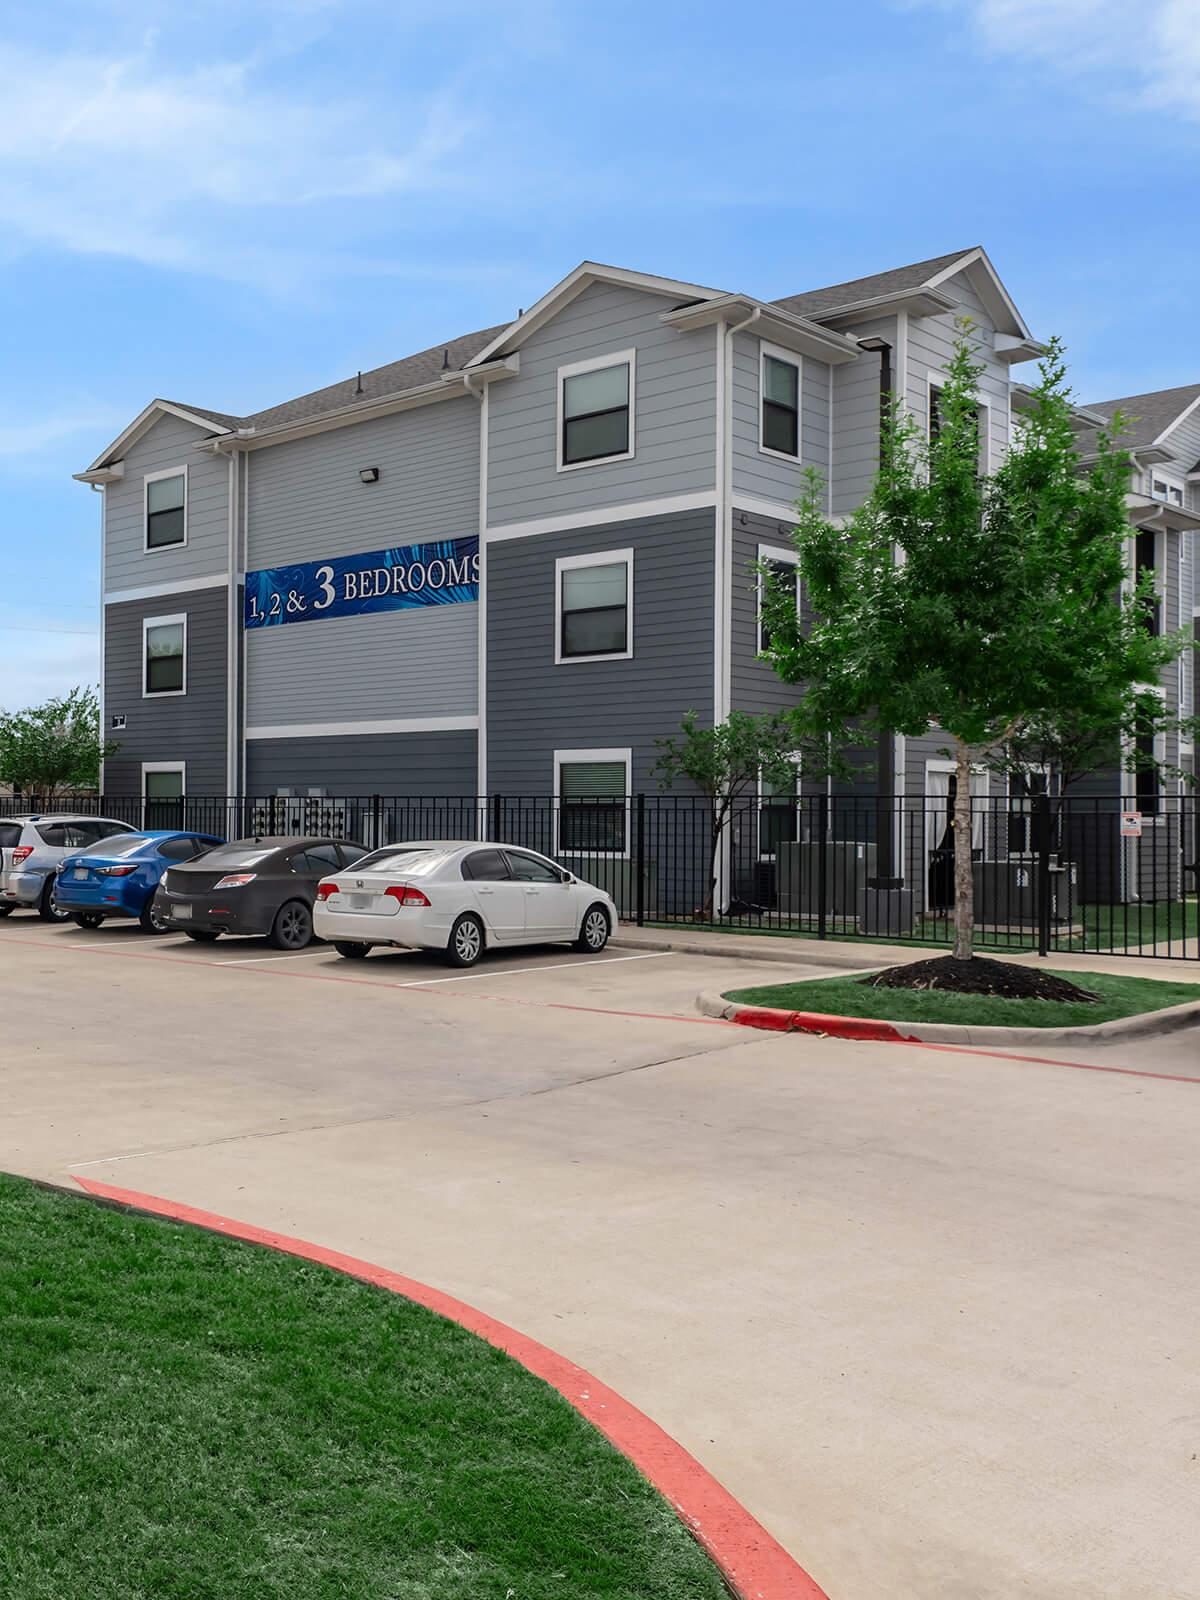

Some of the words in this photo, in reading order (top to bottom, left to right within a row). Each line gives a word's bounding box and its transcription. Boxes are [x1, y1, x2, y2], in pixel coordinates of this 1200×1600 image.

[269, 593, 281, 616] 2
[286, 590, 307, 613] &
[313, 565, 337, 609] 3
